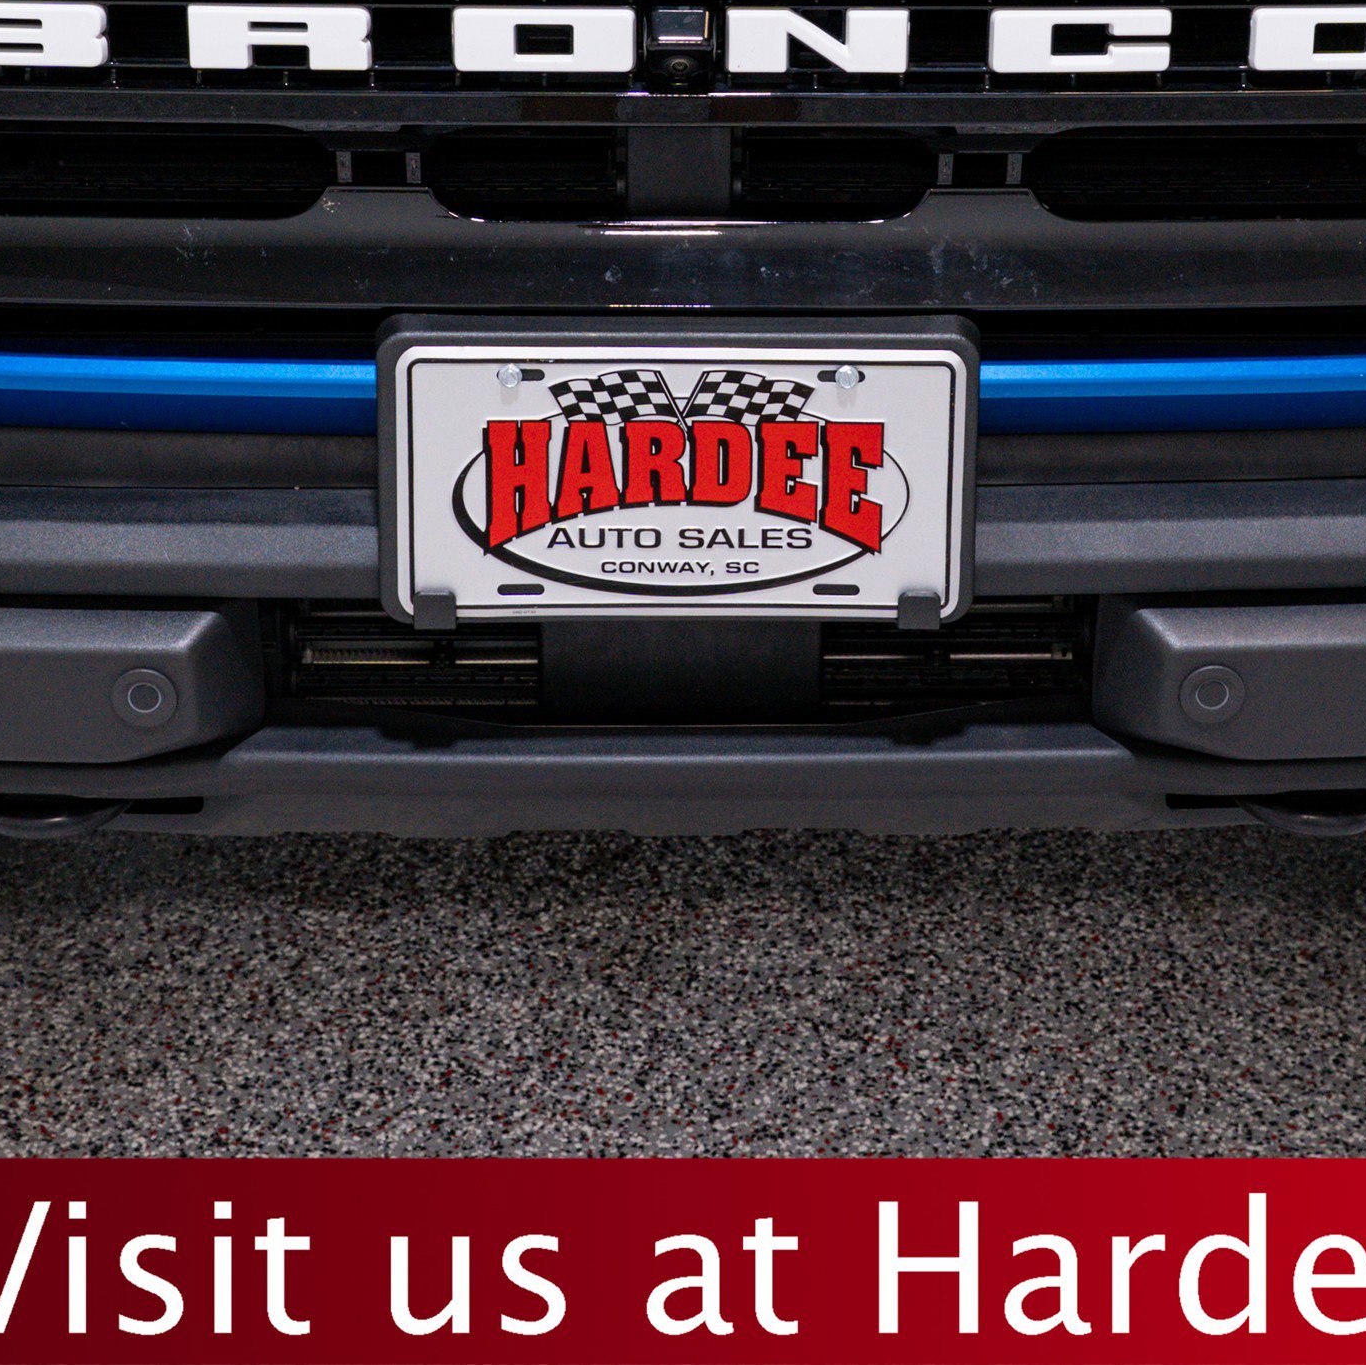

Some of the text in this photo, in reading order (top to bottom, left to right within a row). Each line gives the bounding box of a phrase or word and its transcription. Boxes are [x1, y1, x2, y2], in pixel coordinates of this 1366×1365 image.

[483, 420, 885, 555] HARDEE
[546, 527, 814, 550] AUTO SALES
[600, 560, 760, 577] CONWAY, SC
